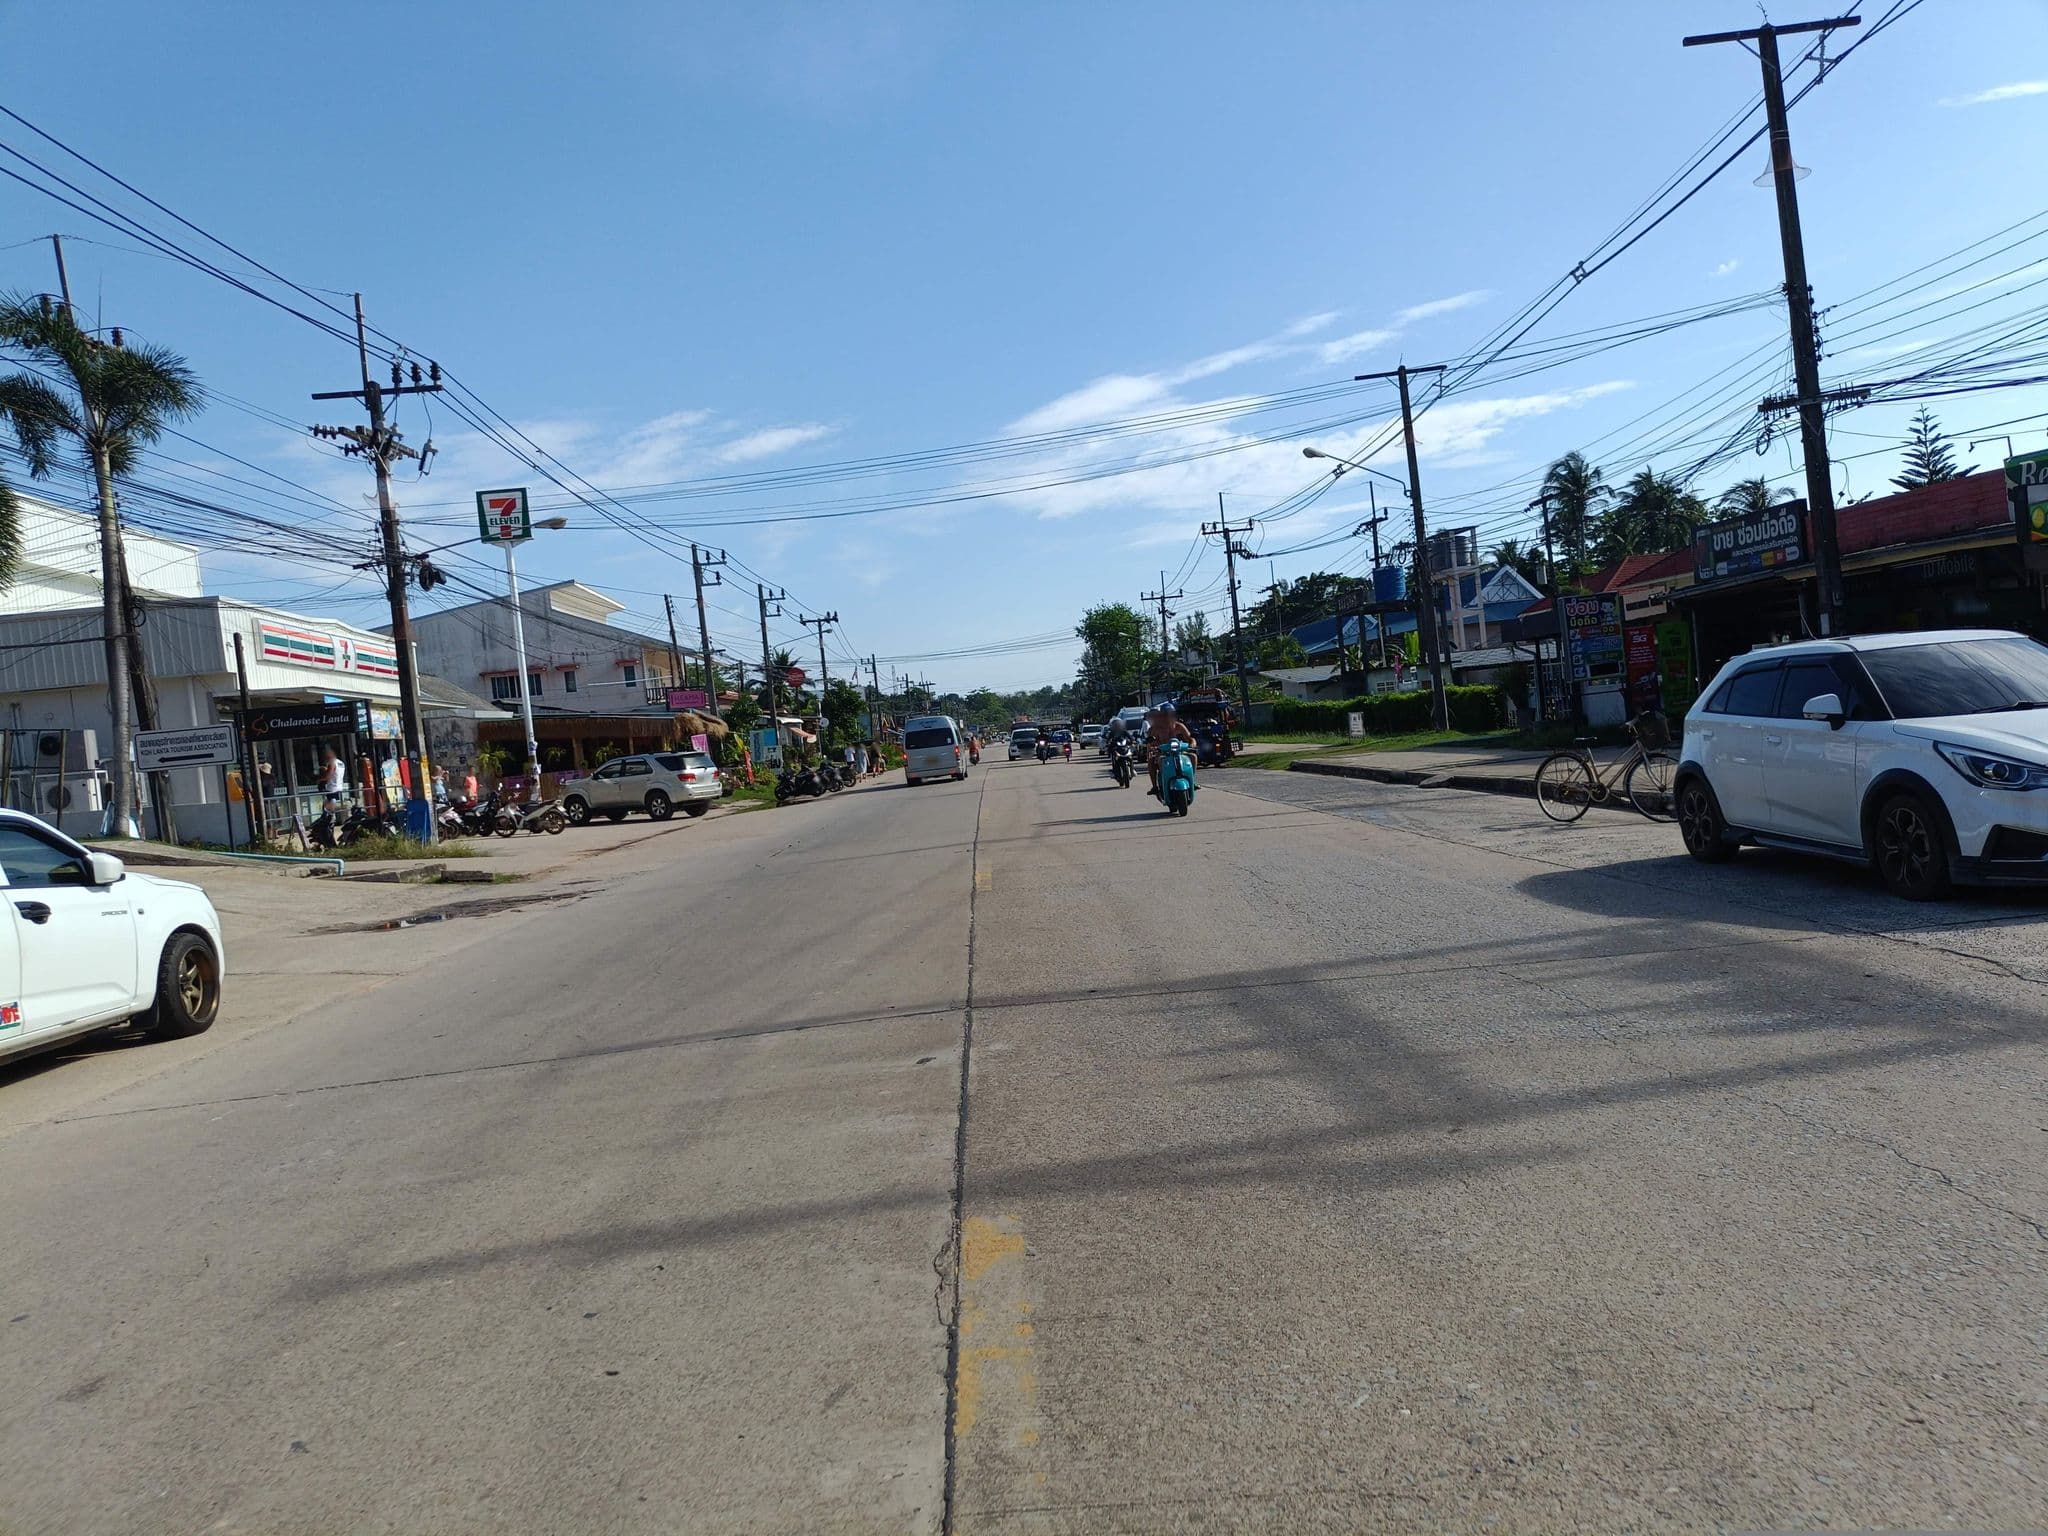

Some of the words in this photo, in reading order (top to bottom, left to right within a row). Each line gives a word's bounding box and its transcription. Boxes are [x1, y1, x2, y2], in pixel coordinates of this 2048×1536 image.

[1713, 530, 1734, 551] ขาย
[1737, 507, 1797, 546] ซ่อมมือถือ
[1566, 598, 1599, 616] ซ่อม
[270, 716, 321, 729] Chalaroste
[322, 713, 350, 724] Lanta
[153, 747, 169, 755] LANTA
[194, 742, 228, 751] ASSOCIATION
